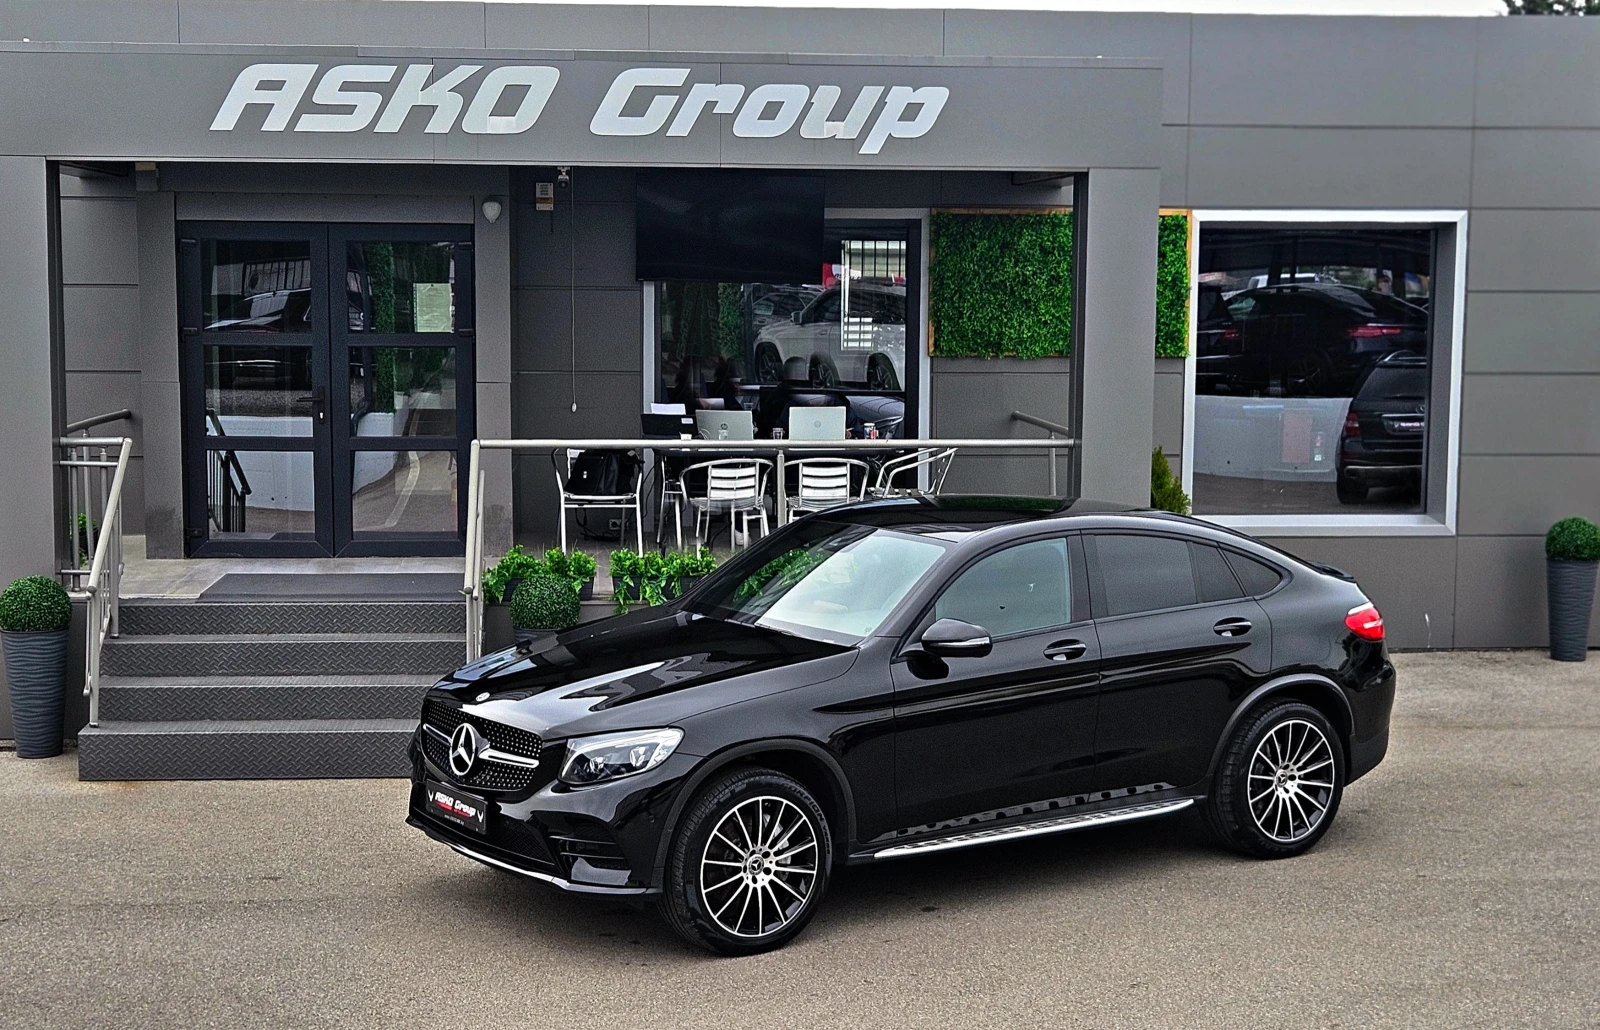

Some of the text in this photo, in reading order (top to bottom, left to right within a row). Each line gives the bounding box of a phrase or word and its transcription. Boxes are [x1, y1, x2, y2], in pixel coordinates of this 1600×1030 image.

[209, 63, 950, 155] ASKO Group
[435, 792, 476, 817] ASKO Group
[775, 781, 825, 822] CORPION
